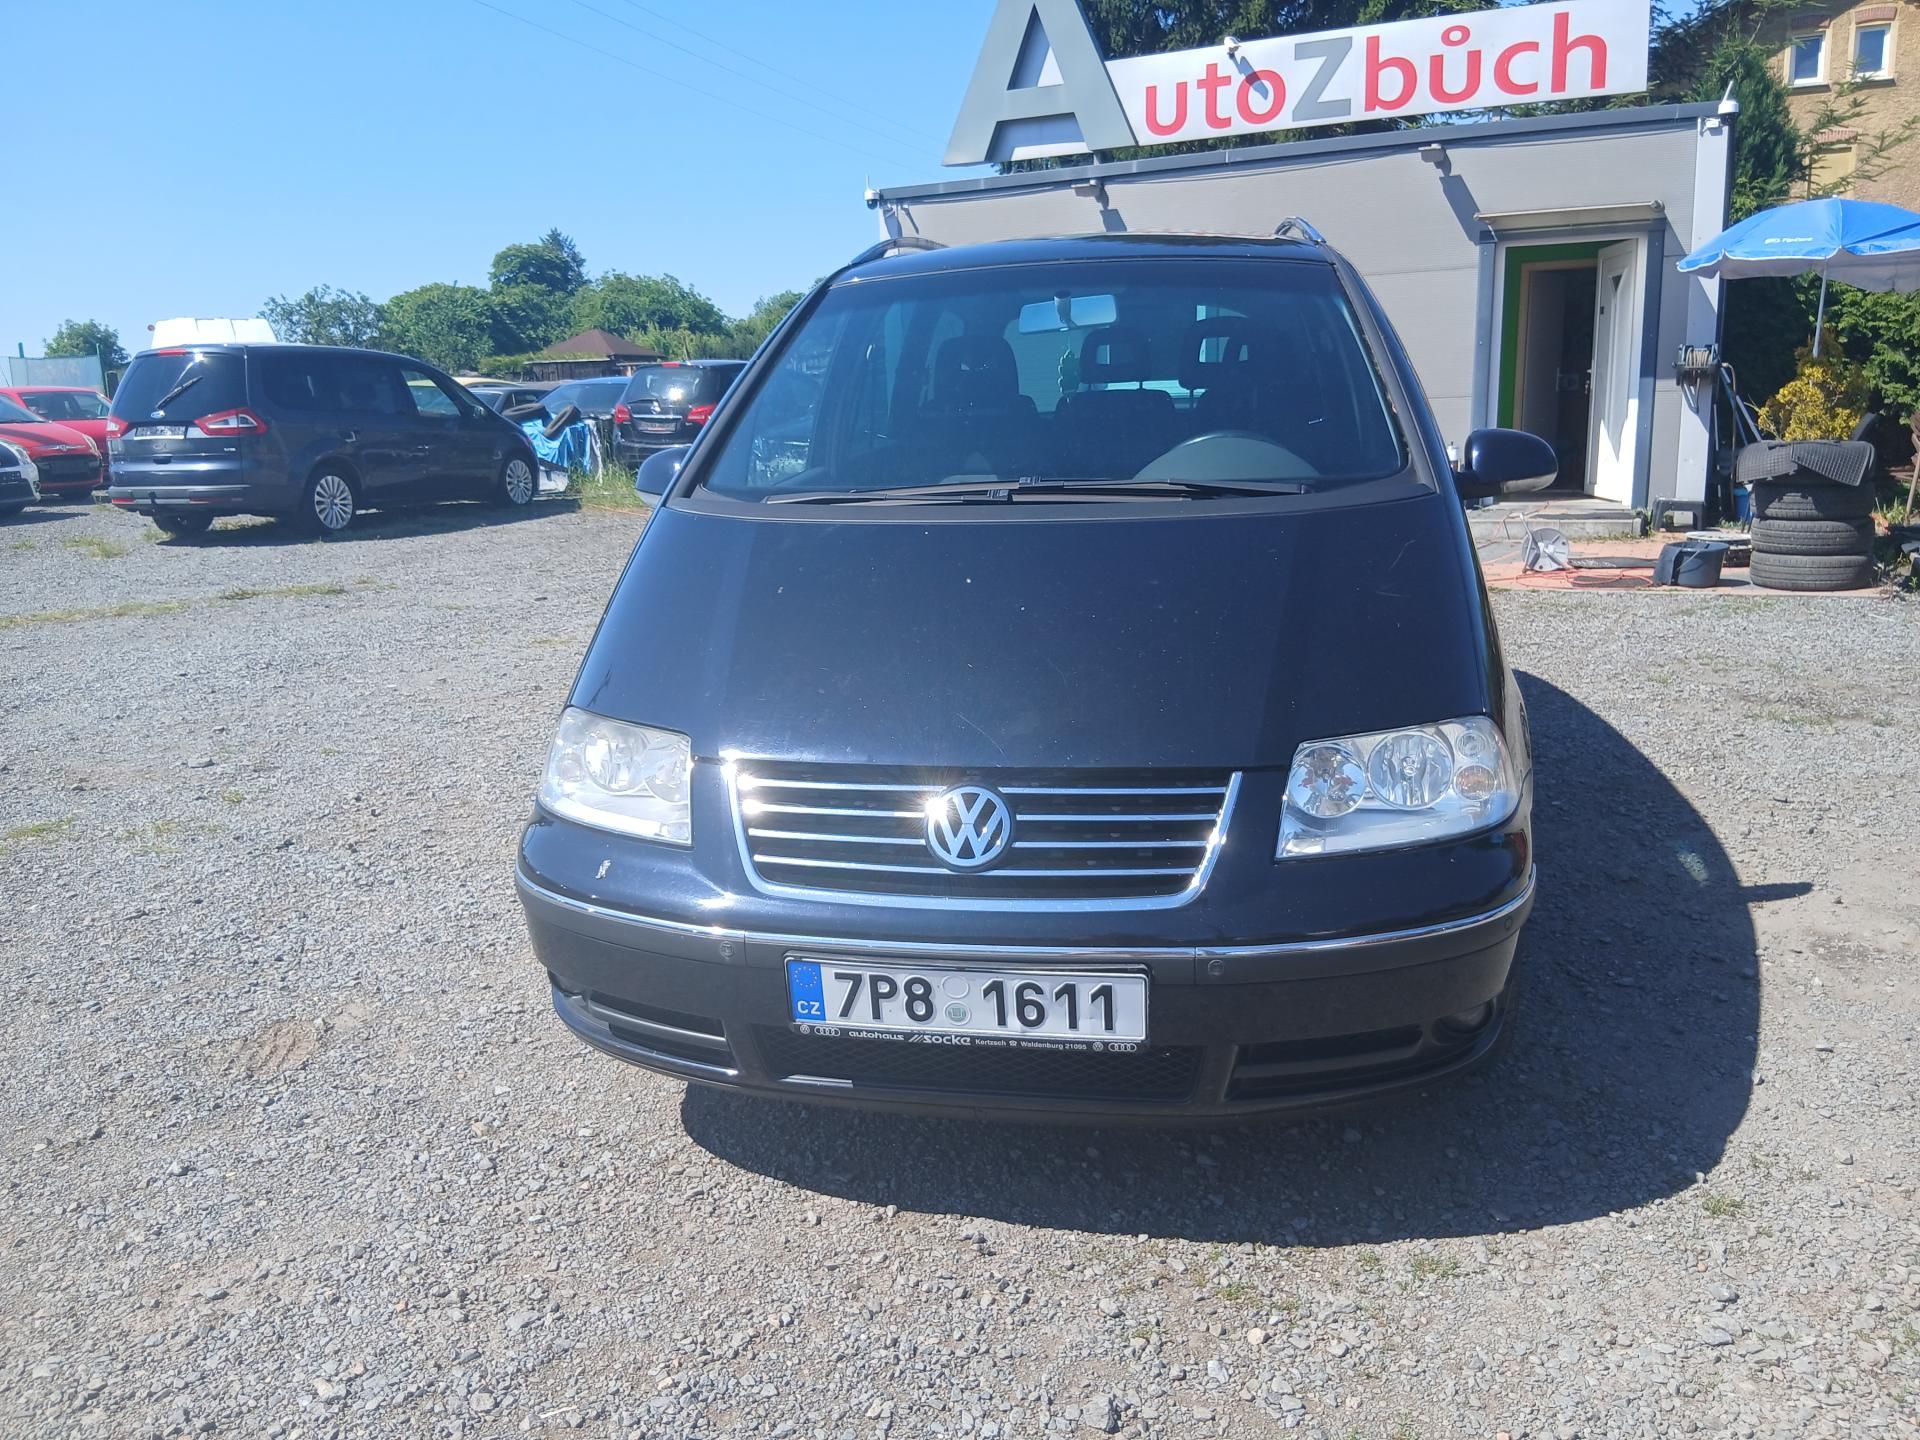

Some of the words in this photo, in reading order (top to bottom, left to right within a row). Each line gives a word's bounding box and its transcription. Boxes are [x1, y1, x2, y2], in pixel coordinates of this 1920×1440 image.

[797, 1001, 821, 1015] CZ
[834, 972, 934, 1022] 7P8
[982, 980, 1114, 1031] 1611
[848, 1030, 905, 1041] autohaus
